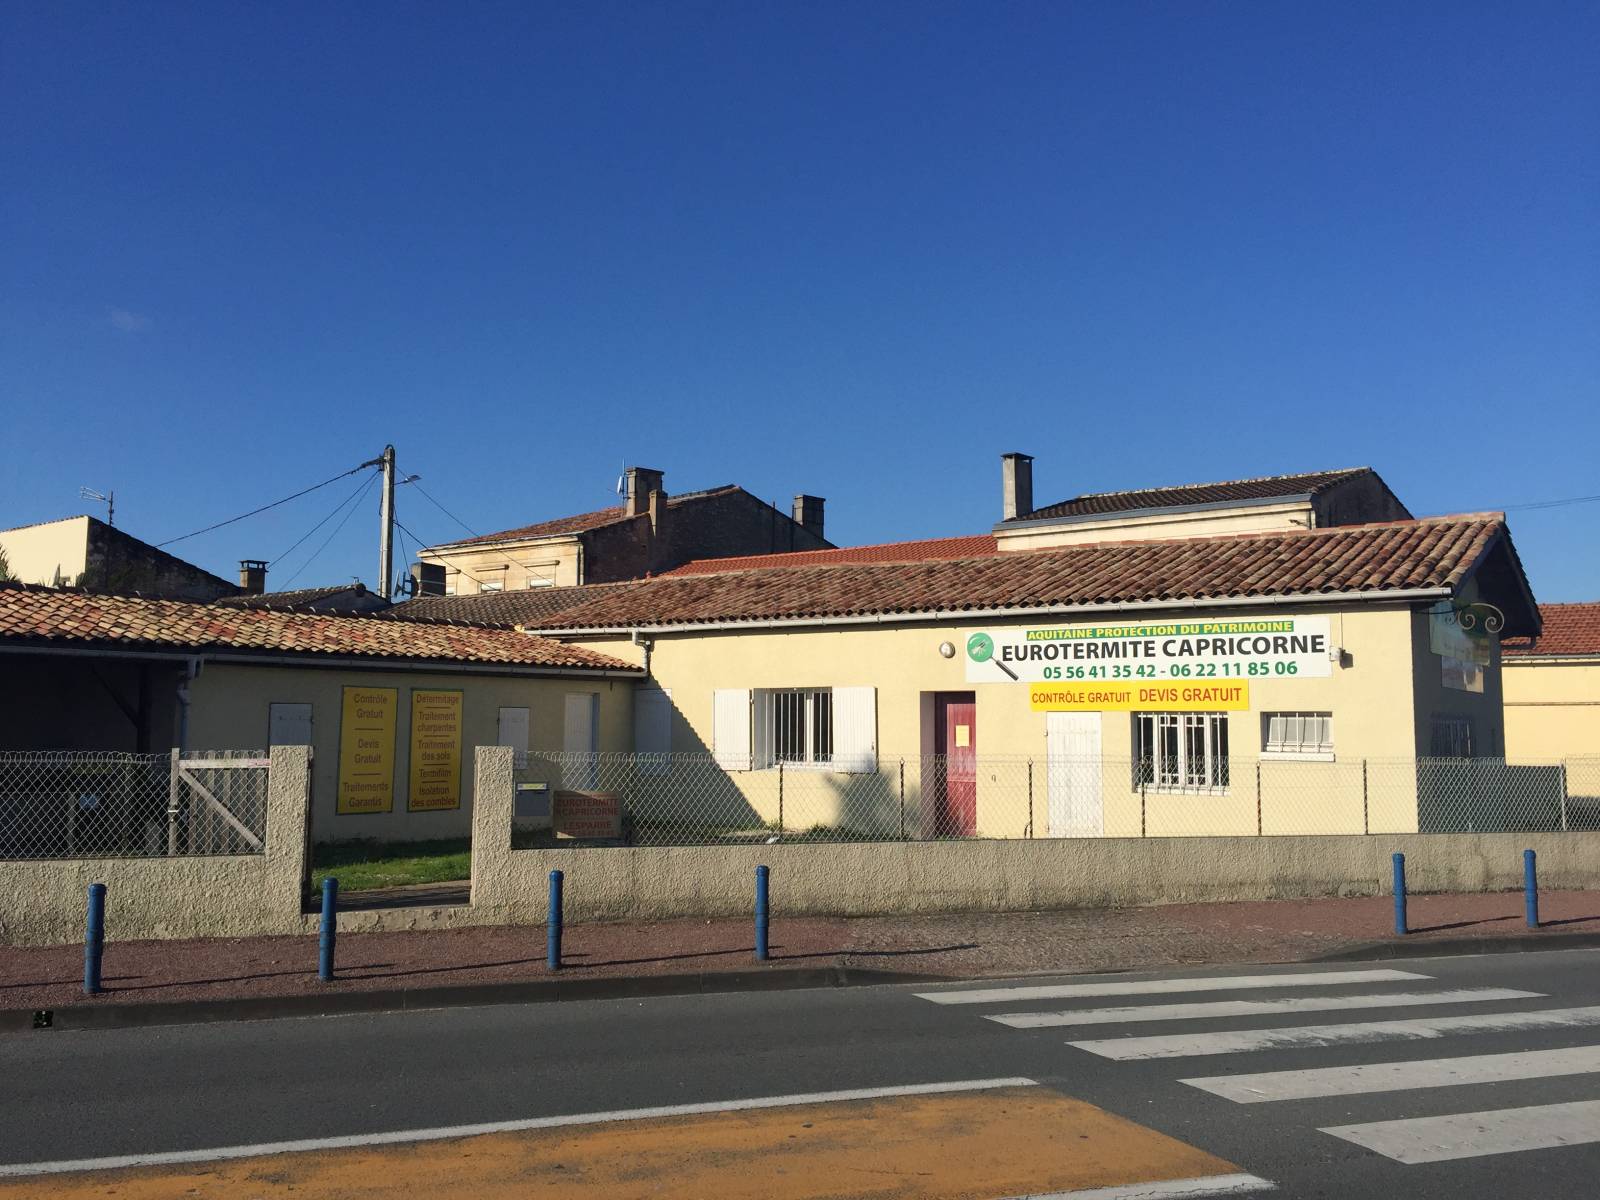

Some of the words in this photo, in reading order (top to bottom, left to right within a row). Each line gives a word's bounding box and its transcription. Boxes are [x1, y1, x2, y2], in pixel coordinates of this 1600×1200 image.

[1028, 629, 1093, 640] AQUITAINE
[1096, 625, 1176, 637] PROTECTION
[1180, 624, 1199, 634] DU
[1203, 621, 1292, 633] PATRIMOINE
[1002, 640, 1156, 662] EUROTERMITE
[1162, 635, 1325, 657] CAPRICORNE
[1043, 666, 1062, 679] 05
[1066, 666, 1084, 679] 56
[1088, 665, 1106, 678] 41
[1112, 665, 1131, 678] 35
[1136, 664, 1156, 677] 42
[1170, 664, 1191, 677] 06
[1195, 663, 1217, 676] 22
[1222, 662, 1241, 676] 11
[1247, 661, 1270, 675] 85
[1275, 660, 1298, 675] 06
[1032, 690, 1085, 704] CONTRÔLE
[1088, 691, 1132, 703] GRATUIT
[1139, 688, 1178, 702] DEVIS
[1182, 687, 1242, 701] GRATUIT
